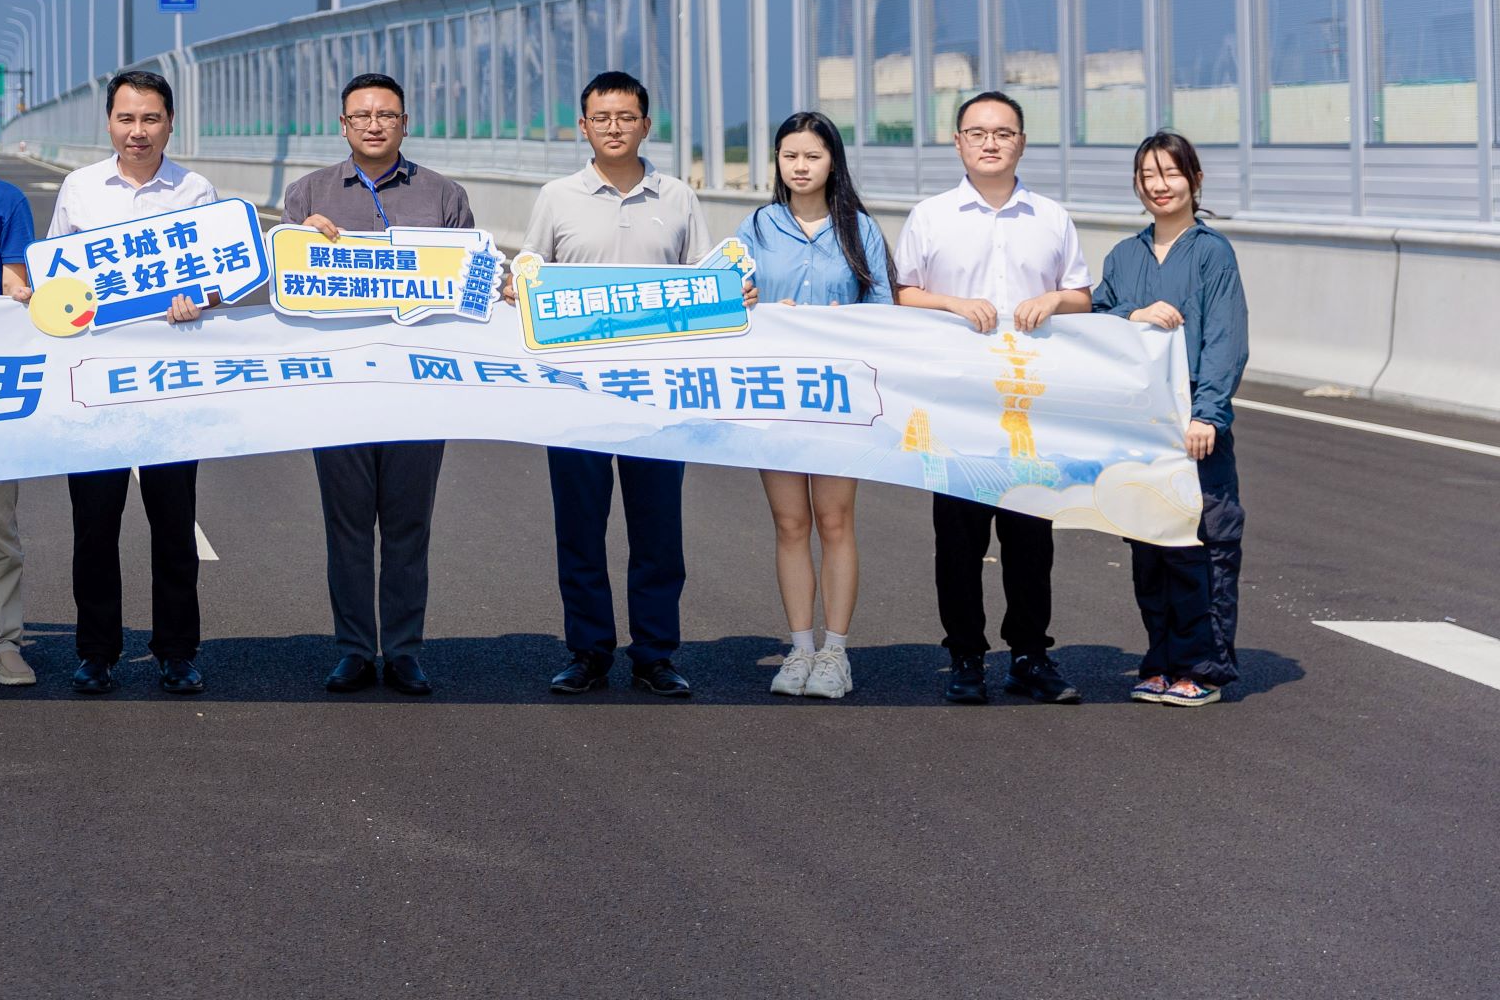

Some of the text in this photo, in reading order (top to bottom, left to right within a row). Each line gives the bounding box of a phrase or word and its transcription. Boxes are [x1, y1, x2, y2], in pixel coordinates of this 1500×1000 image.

[46, 221, 198, 277] 人民城市
[94, 241, 250, 300] 美好生活
[309, 246, 417, 271] 聚焦高质量
[535, 275, 719, 319] E路同行看芜湖
